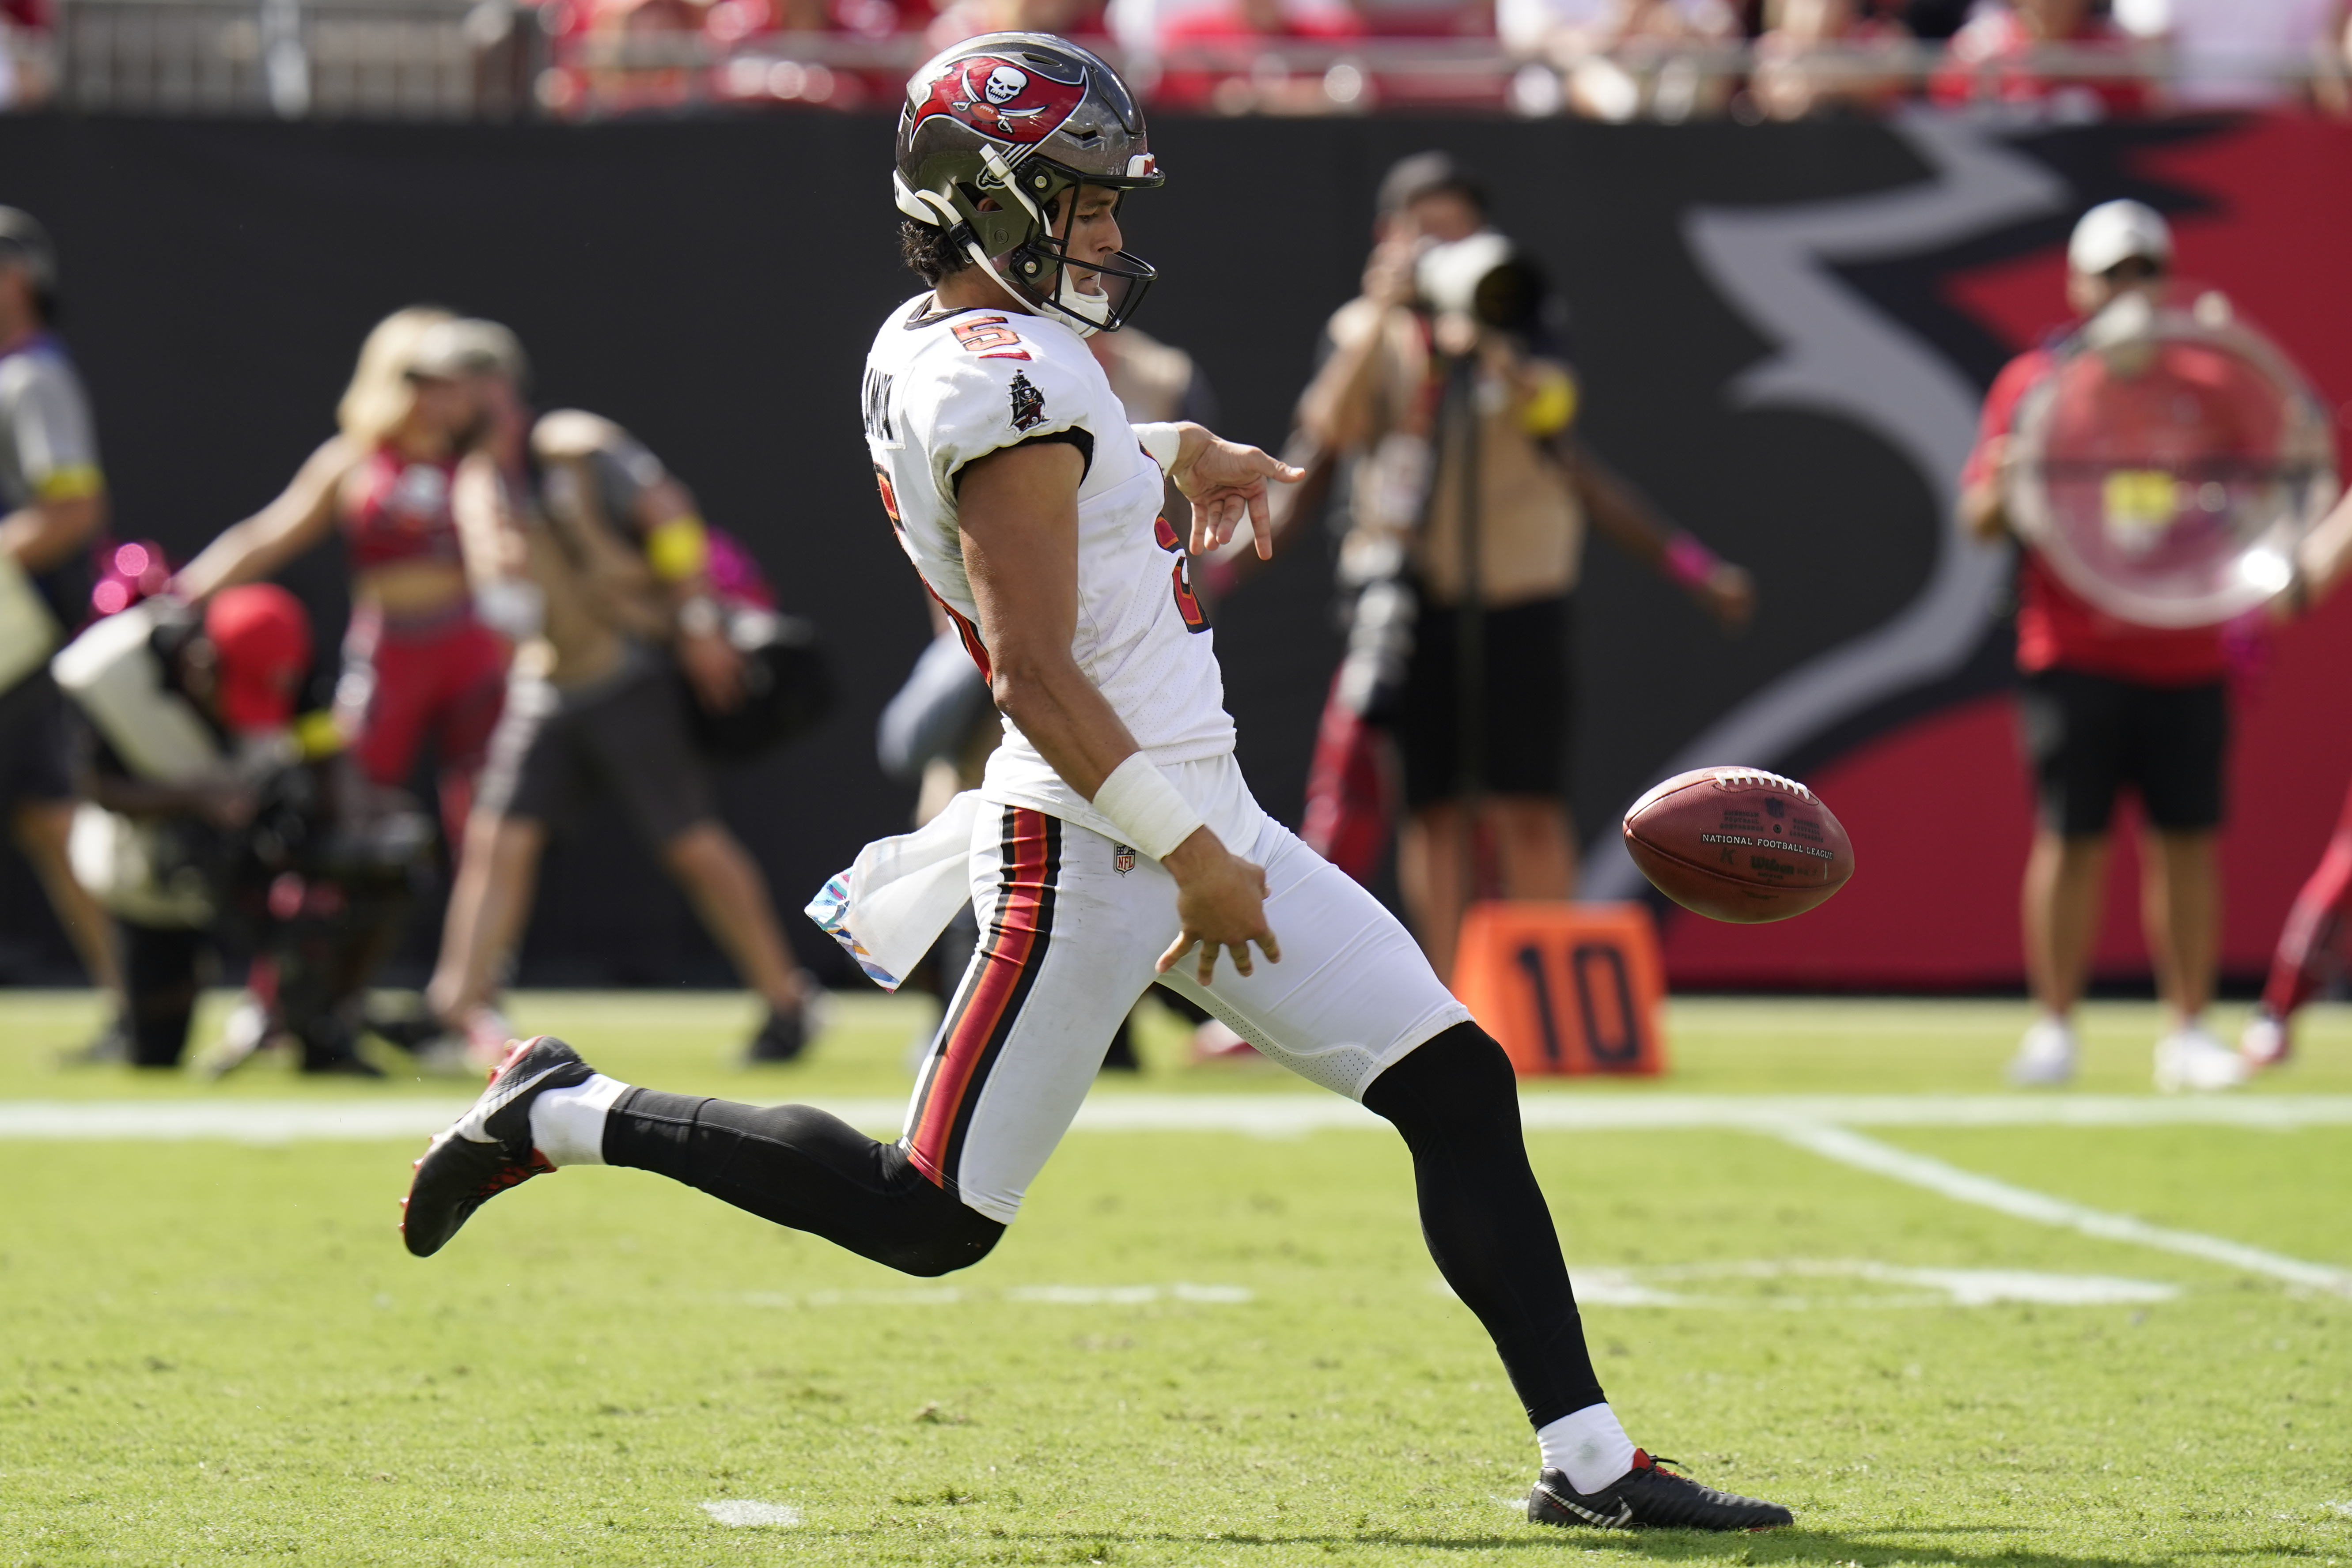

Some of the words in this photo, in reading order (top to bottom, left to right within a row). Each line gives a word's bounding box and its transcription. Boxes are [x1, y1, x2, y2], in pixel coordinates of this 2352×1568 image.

[950, 316, 1024, 353] 5
[1703, 834, 1752, 845] NATIONAL
[1757, 839, 1803, 852] FOOTBALL
[1807, 846, 1833, 860] LEAGUE
[1117, 856, 1133, 870] NFL
[1519, 946, 1640, 1061] 10
